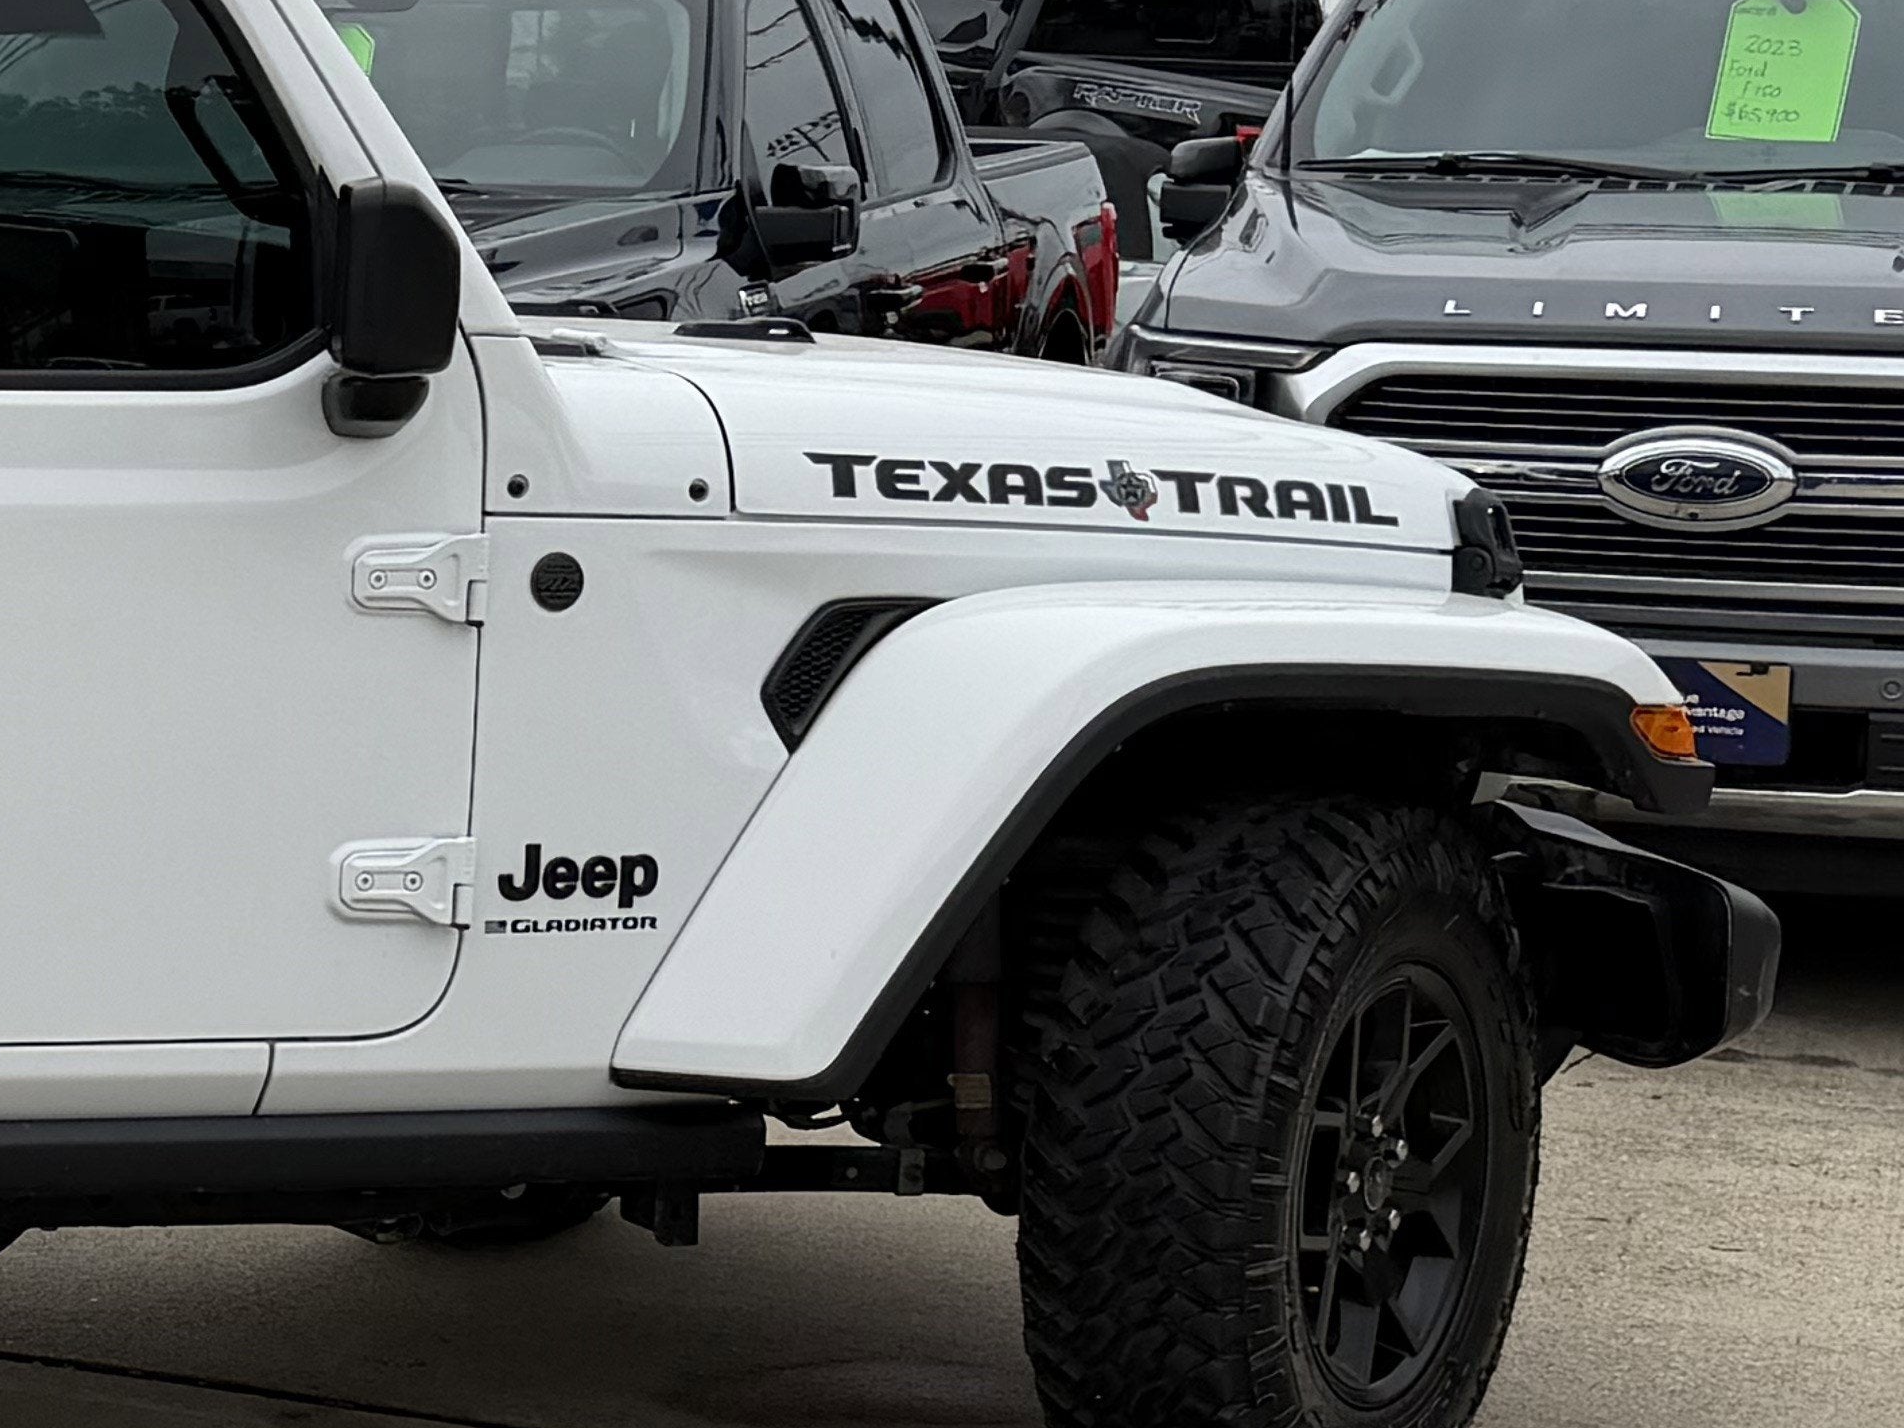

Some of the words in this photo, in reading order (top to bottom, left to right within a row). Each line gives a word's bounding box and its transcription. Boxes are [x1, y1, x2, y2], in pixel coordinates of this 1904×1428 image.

[1743, 34, 1804, 57] 2023
[1442, 299, 1904, 326] LIMITE
[802, 451, 1097, 508] TEXAS
[1147, 469, 1399, 528] TRAIL
[1650, 457, 1743, 497] Ford
[497, 843, 659, 909] Jeep
[510, 915, 659, 934] GLADIATOR
